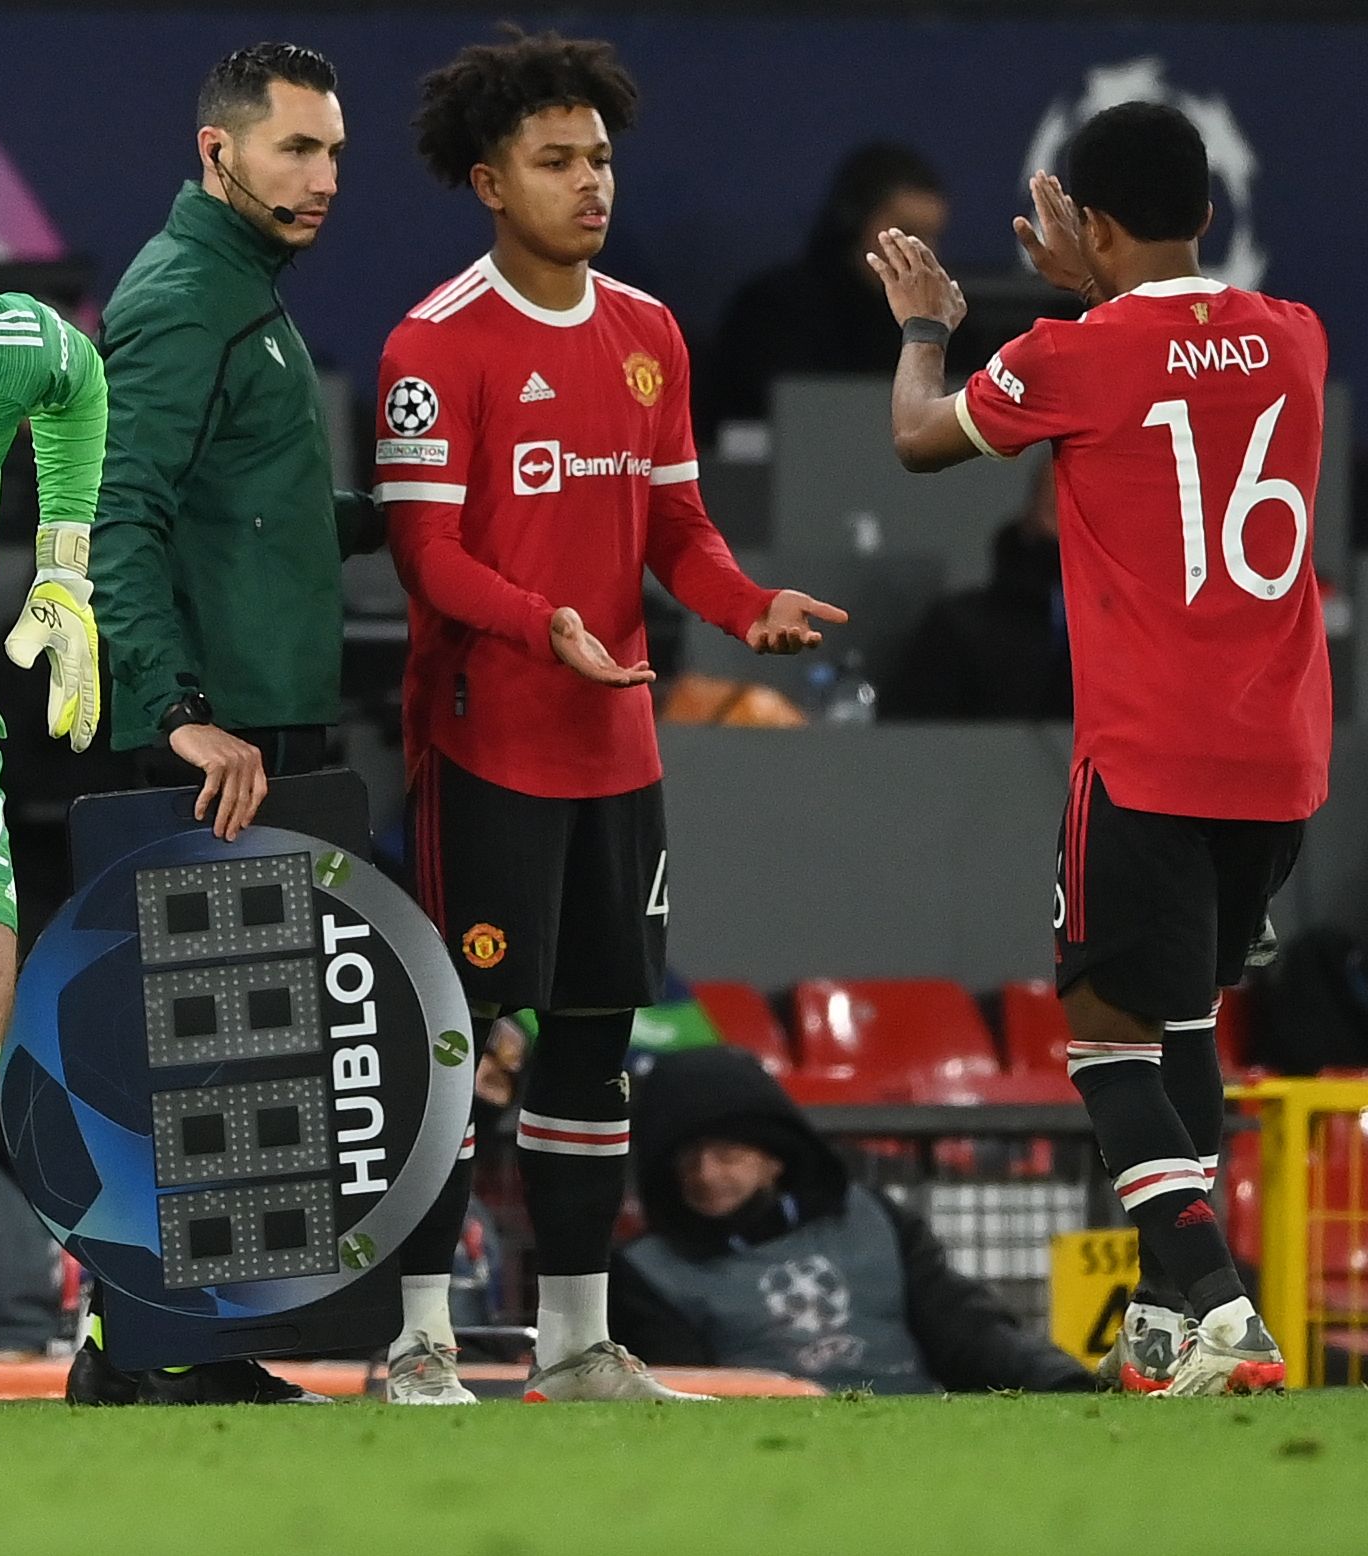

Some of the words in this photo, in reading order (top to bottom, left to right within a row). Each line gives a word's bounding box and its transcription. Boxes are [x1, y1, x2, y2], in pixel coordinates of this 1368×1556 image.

[1166, 334, 1269, 379] AMAD
[1142, 394, 1307, 606] 16
[646, 850, 669, 927] 4
[322, 914, 388, 1195] HUBLOT
